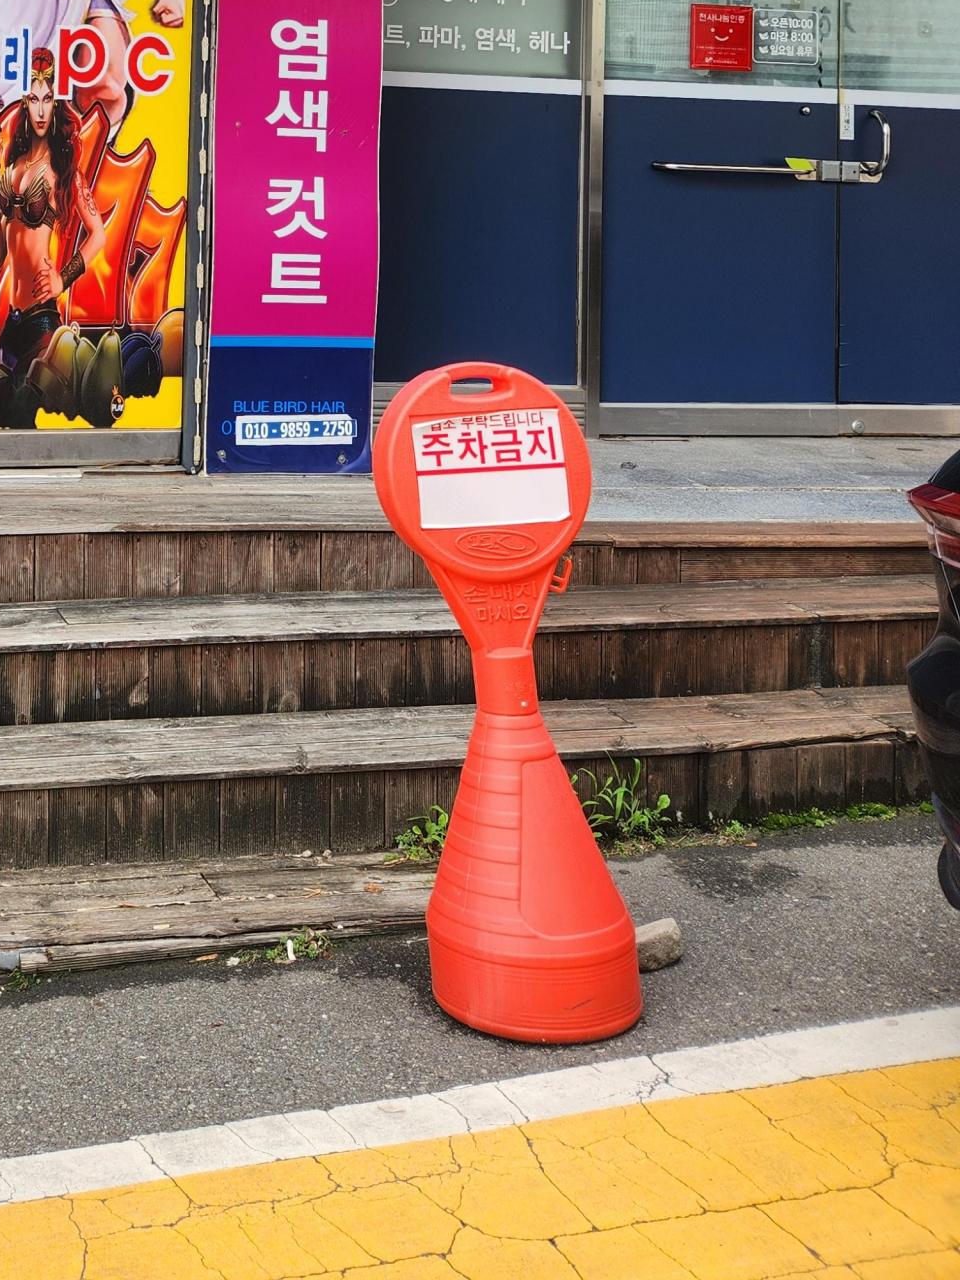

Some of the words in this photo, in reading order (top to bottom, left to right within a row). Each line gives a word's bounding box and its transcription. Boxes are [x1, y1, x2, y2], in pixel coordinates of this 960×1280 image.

[528, 30, 571, 55] 헤나
[770, 31, 789, 42] 마감
[790, 32, 814, 43] 8:00
[265, 18, 328, 153] 염색
[233, 400, 270, 413] BLUE
[274, 401, 307, 413] BIRD
[311, 401, 345, 413] HAIR
[461, 411, 544, 430] 부탁드립니다
[421, 426, 557, 467] 주차금지
[463, 580, 537, 605] 손대지
[477, 602, 531, 624] 마시오
